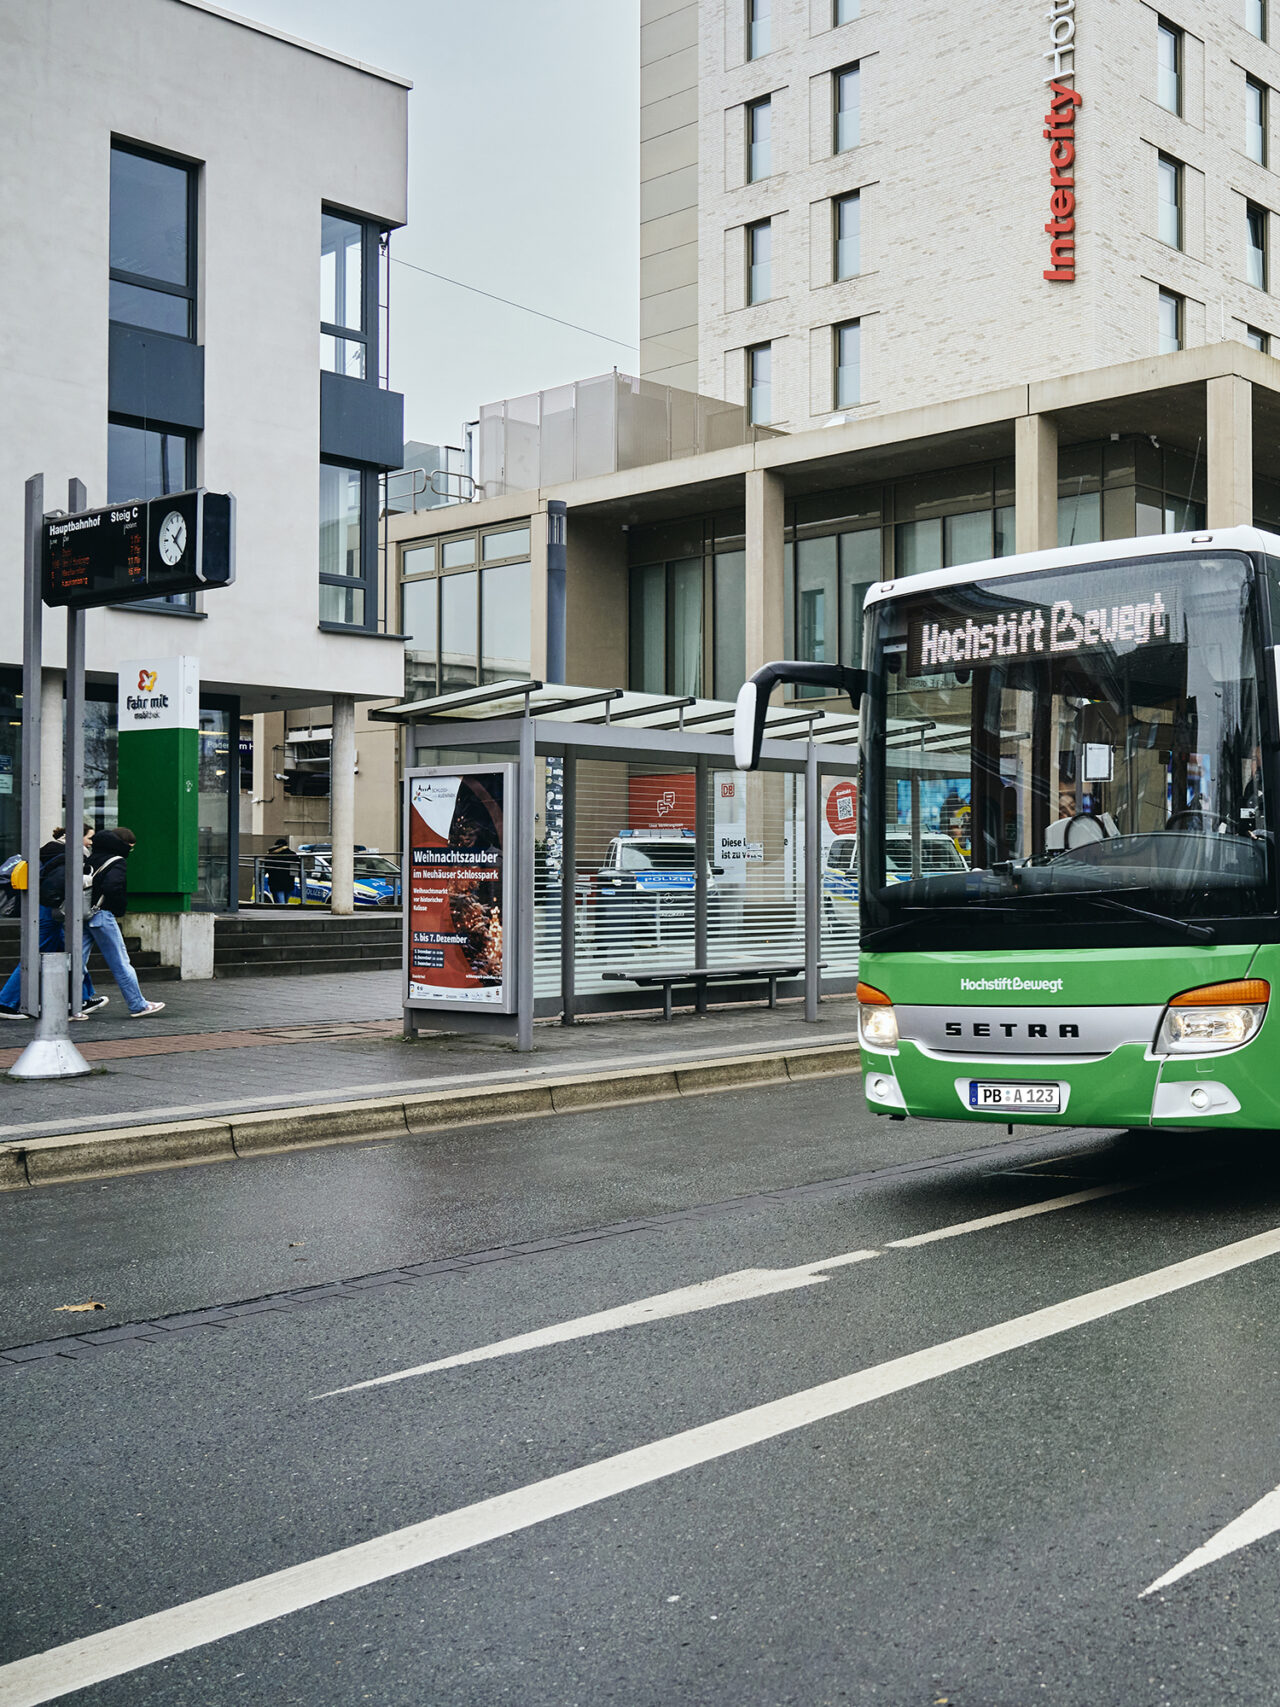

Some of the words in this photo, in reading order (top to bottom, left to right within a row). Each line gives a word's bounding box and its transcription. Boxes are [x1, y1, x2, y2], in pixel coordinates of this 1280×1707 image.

[49, 515, 101, 536] Hauptbahnhof
[111, 510, 131, 522] Steig
[132, 507, 138, 518] C
[127, 695, 149, 710] fahr
[150, 694, 168, 708] mit
[722, 784, 733, 796] DB
[722, 838, 742, 847] Diese
[413, 850, 498, 863] Weihnachtszauber
[722, 850, 731, 859] ist
[413, 869, 421, 879] im
[423, 869, 457, 879] Neuhäuser
[457, 870, 499, 881] Schlosspark
[414, 934, 420, 942] 5.
[420, 933, 429, 942] bis
[430, 934, 436, 942] 7.
[436, 934, 468, 944] Dezember
[945, 1022, 1079, 1038] SETRA
[983, 1089, 1002, 1103] PB
[1013, 1089, 1023, 1103] A
[1026, 1089, 1054, 1103] 123
